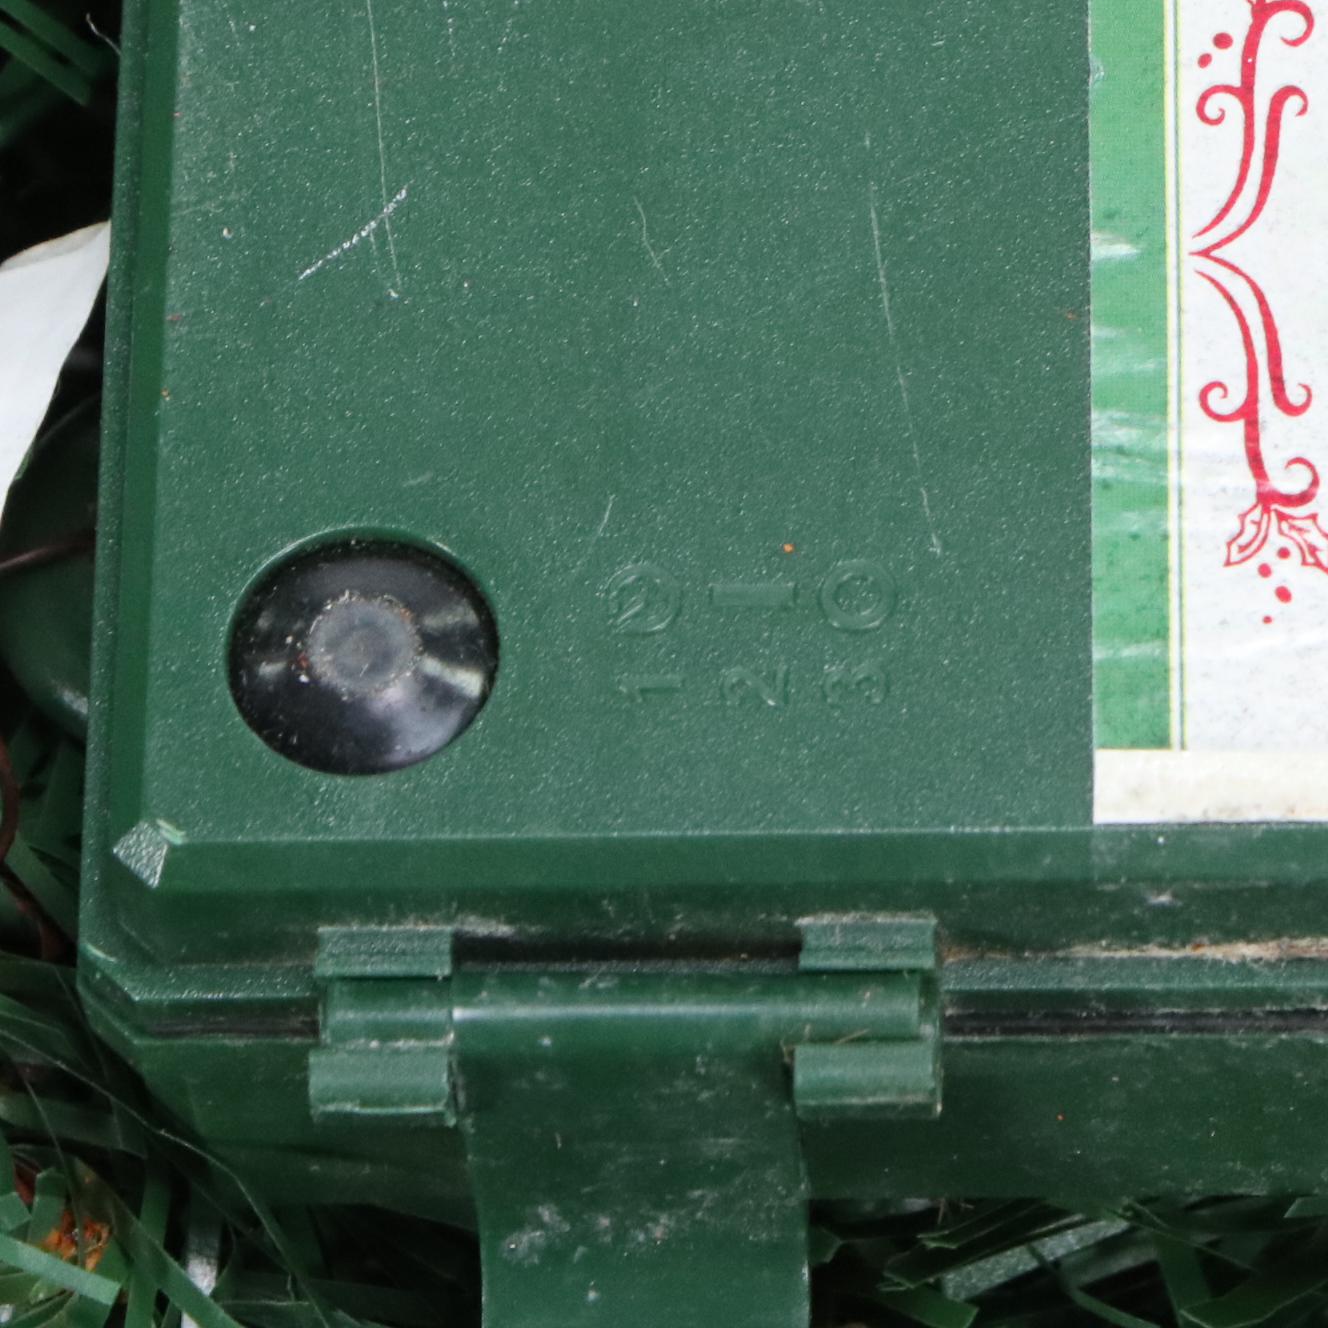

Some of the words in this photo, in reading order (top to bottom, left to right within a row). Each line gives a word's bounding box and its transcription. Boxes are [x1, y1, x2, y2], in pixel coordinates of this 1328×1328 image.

[618, 673, 686, 701] 1
[720, 665, 789, 707] 2
[823, 662, 889, 706] 3
